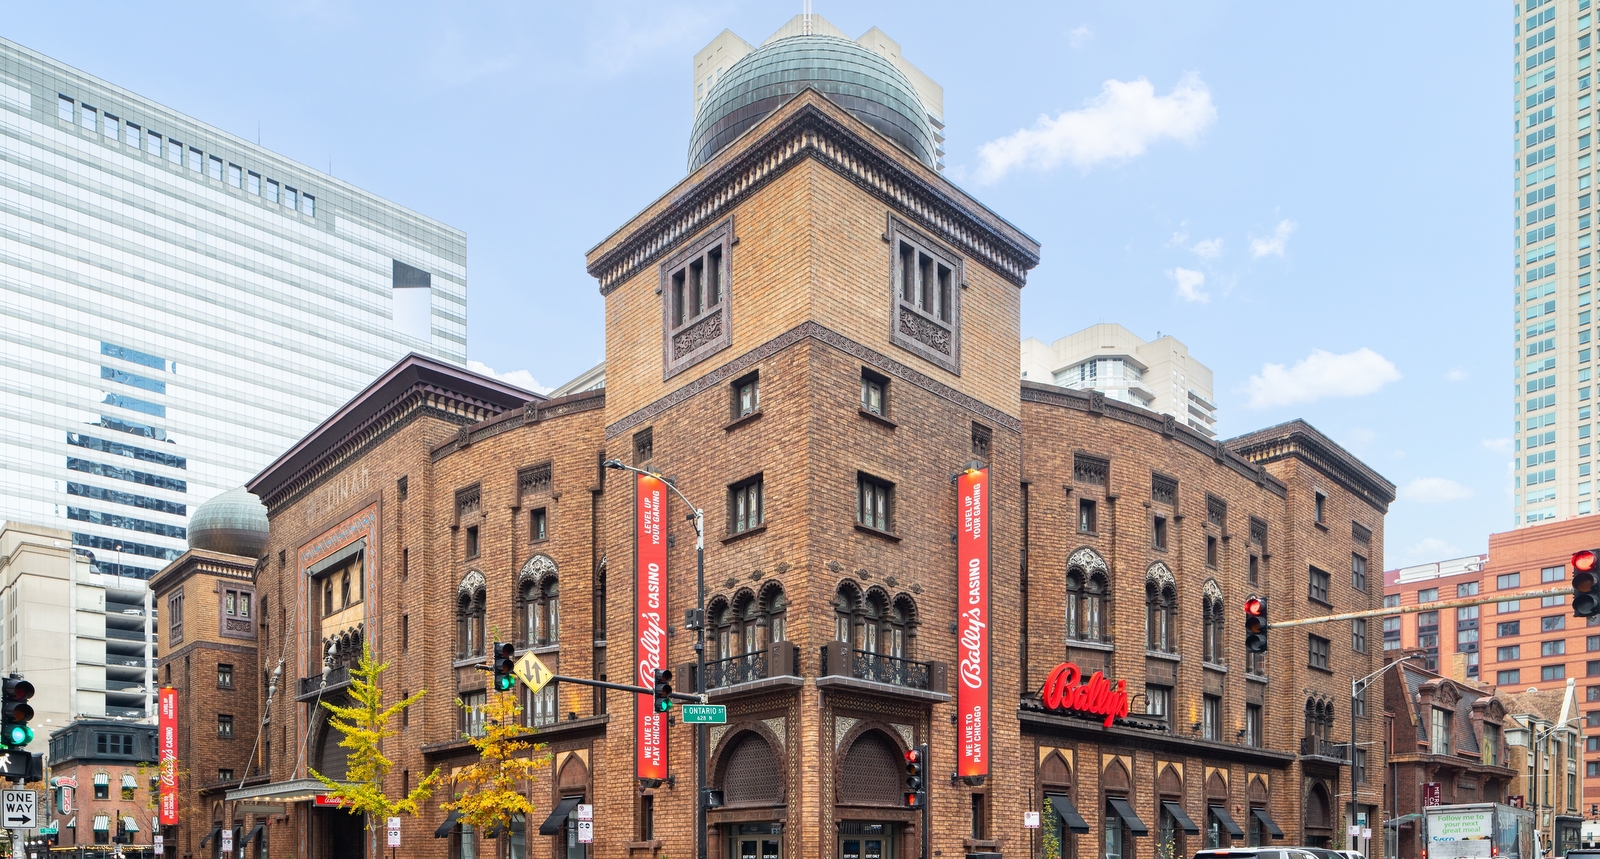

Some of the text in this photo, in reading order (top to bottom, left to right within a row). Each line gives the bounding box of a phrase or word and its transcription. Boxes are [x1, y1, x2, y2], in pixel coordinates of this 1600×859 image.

[644, 498, 651, 508] UP
[965, 496, 972, 507] UP
[640, 563, 665, 690] Bally's CASINO
[960, 558, 986, 689] Bally's CASINO
[1044, 662, 1128, 728] Bally's
[644, 716, 651, 726] TO
[966, 714, 973, 725] TO
[644, 746, 651, 758] WE
[966, 744, 973, 757] WE
[161, 750, 176, 786] Bally's
[6, 793, 32, 802] ONE
[6, 804, 33, 812] WAY
